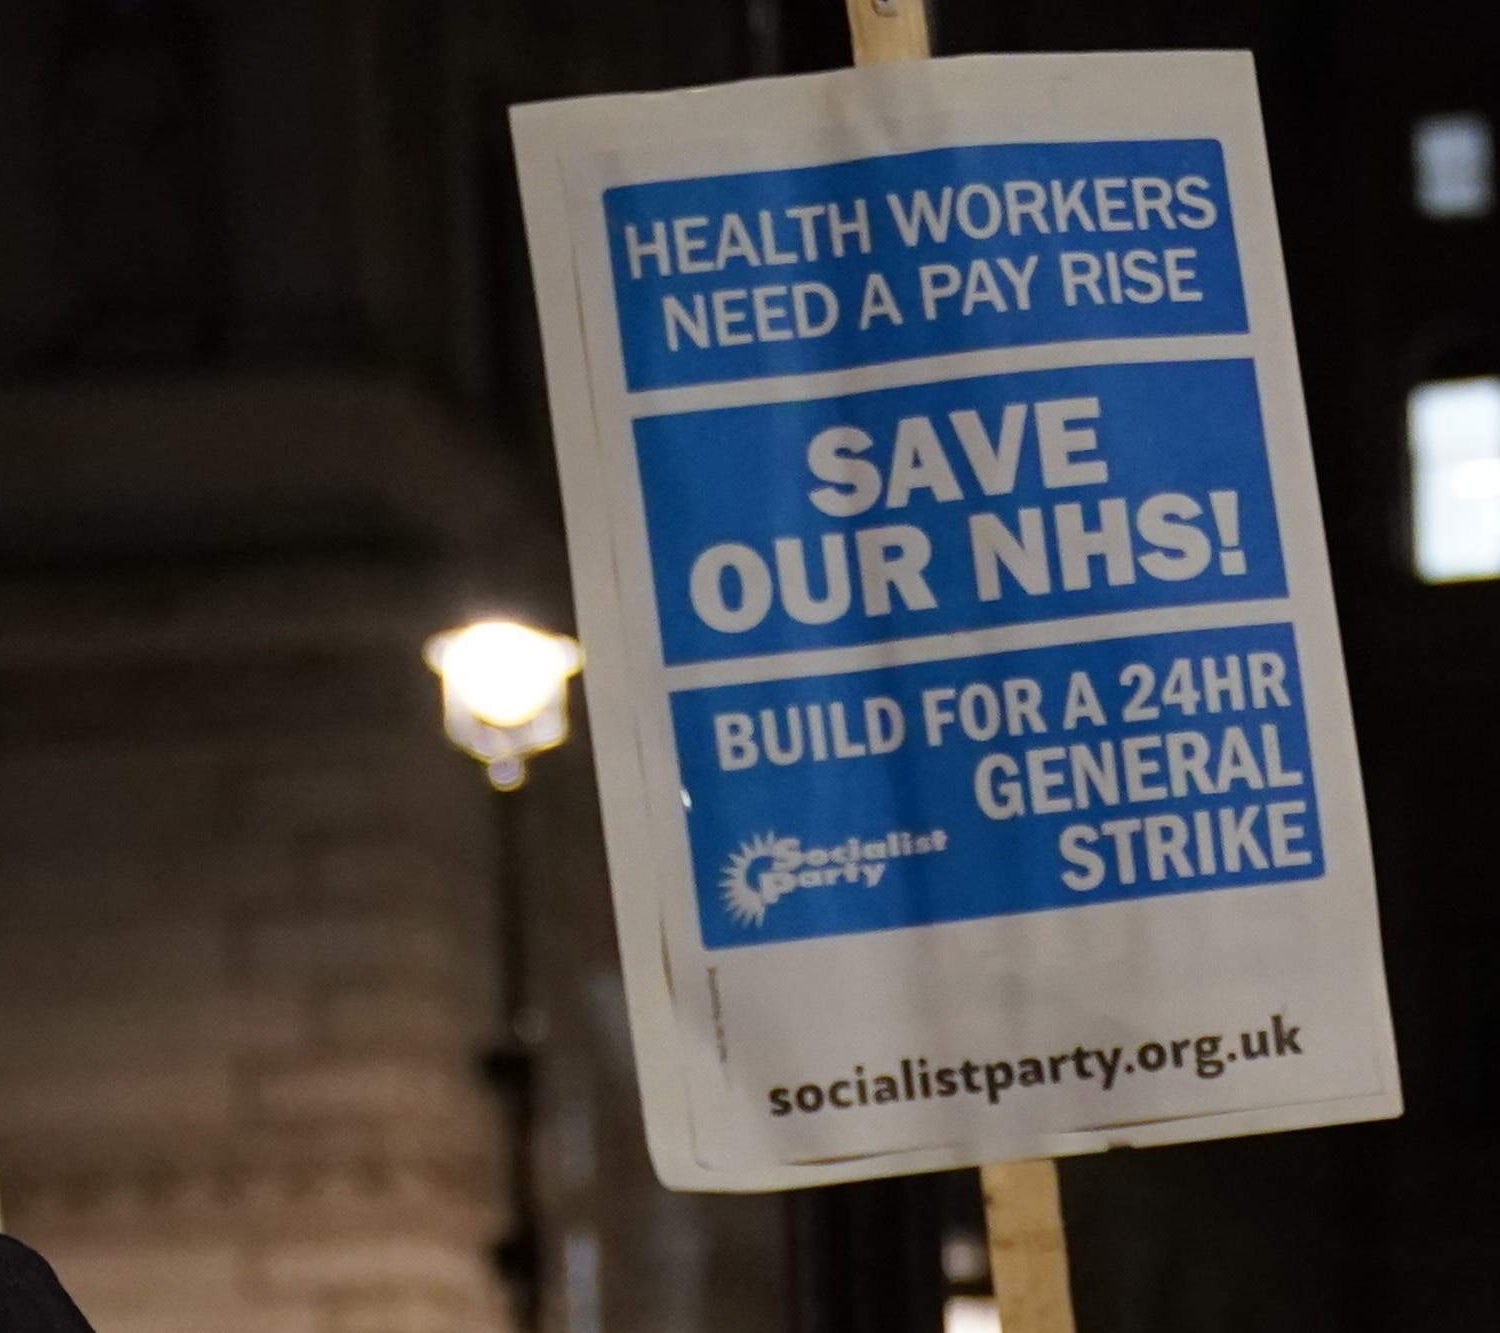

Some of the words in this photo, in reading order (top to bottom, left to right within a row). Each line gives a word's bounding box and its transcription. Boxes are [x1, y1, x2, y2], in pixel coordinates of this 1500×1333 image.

[623, 197, 874, 281] HEALTH
[887, 174, 1219, 248] WORKERS
[661, 279, 840, 353] NEED
[859, 272, 905, 332] A
[920, 258, 1039, 323] PAY
[1063, 247, 1206, 308] RISE
[806, 394, 1109, 519] SAVE
[688, 520, 939, 637] OUR
[967, 488, 1248, 604] NHS!
[714, 695, 907, 774] BUILD
[925, 677, 1047, 748] FOR
[1063, 670, 1108, 731] A
[1121, 650, 1292, 725] 24HR
[973, 721, 1305, 824] GENERAL
[1056, 800, 1315, 894] STRIKE
[767, 1012, 1306, 1119] socialistparty.org.uk
